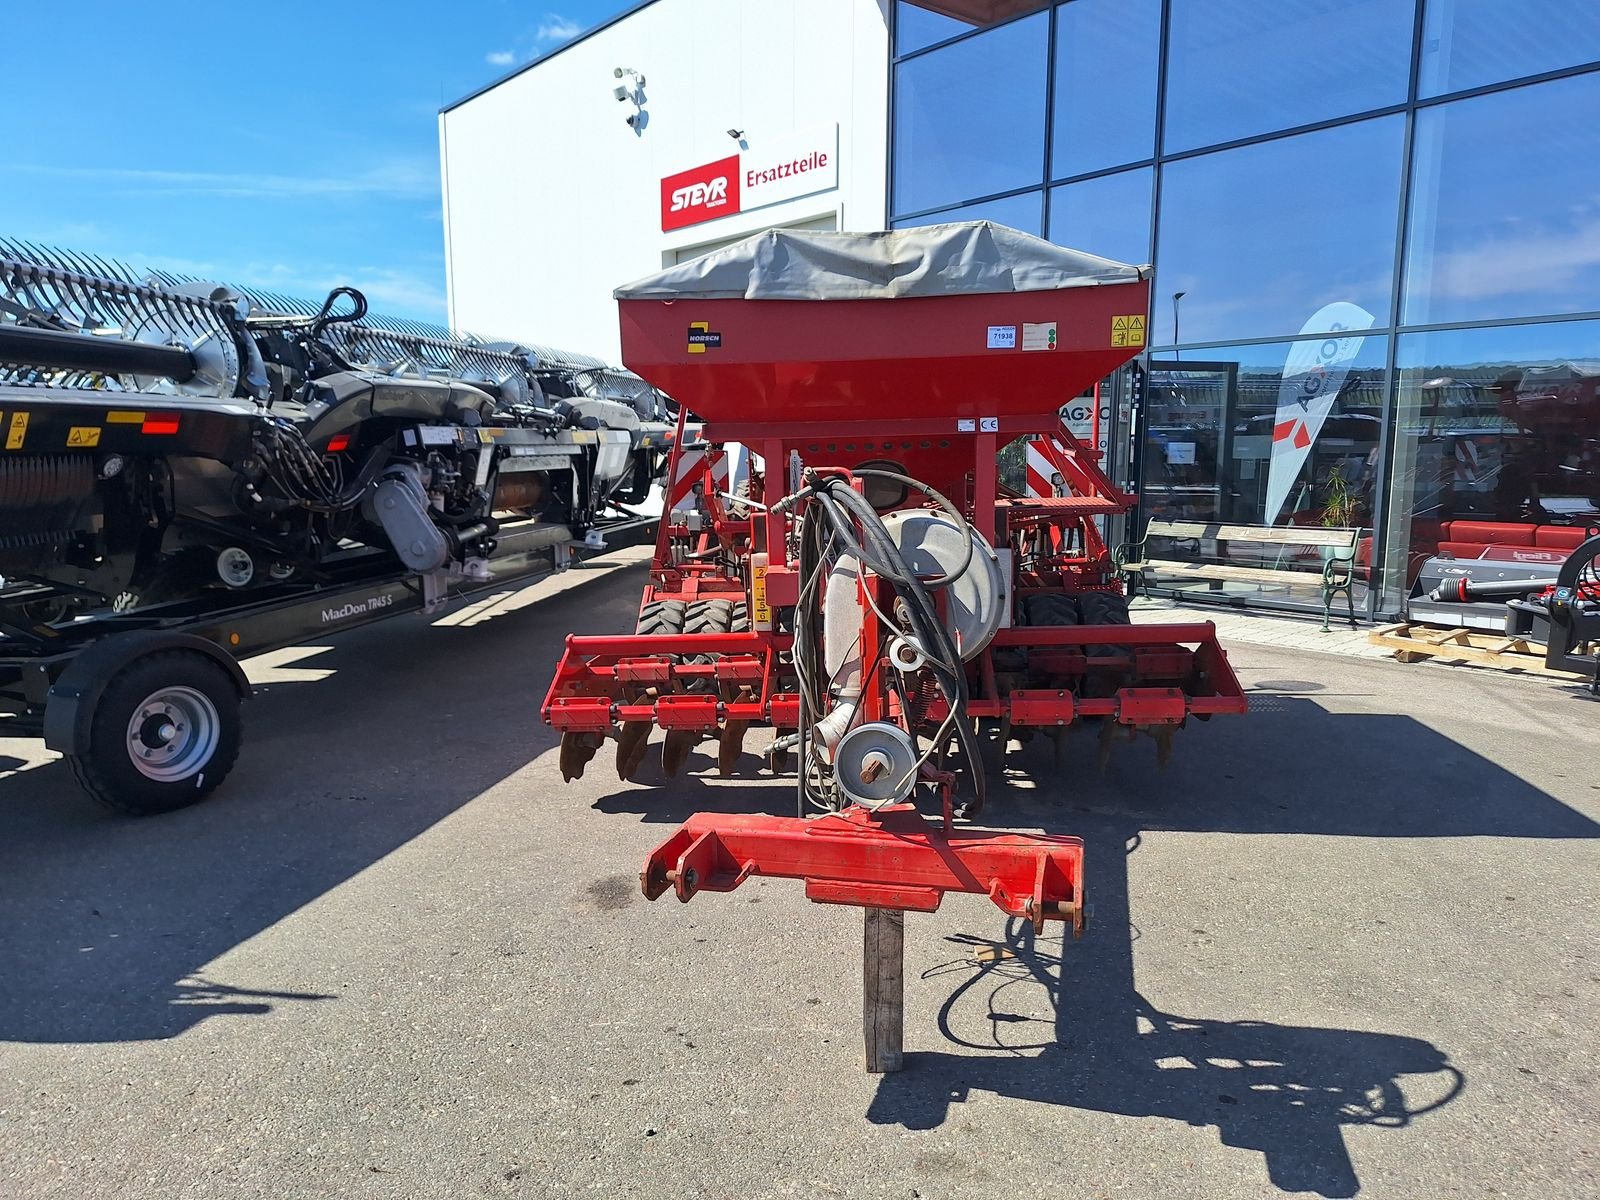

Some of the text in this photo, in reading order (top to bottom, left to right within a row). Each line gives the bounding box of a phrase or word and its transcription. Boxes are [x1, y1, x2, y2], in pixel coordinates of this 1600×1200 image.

[747, 152, 828, 187] Ersatzteile
[670, 176, 728, 212] STEYR
[993, 332, 1013, 340] 71938
[980, 419, 997, 430] CE
[321, 594, 392, 622] MacDon TR45 S
